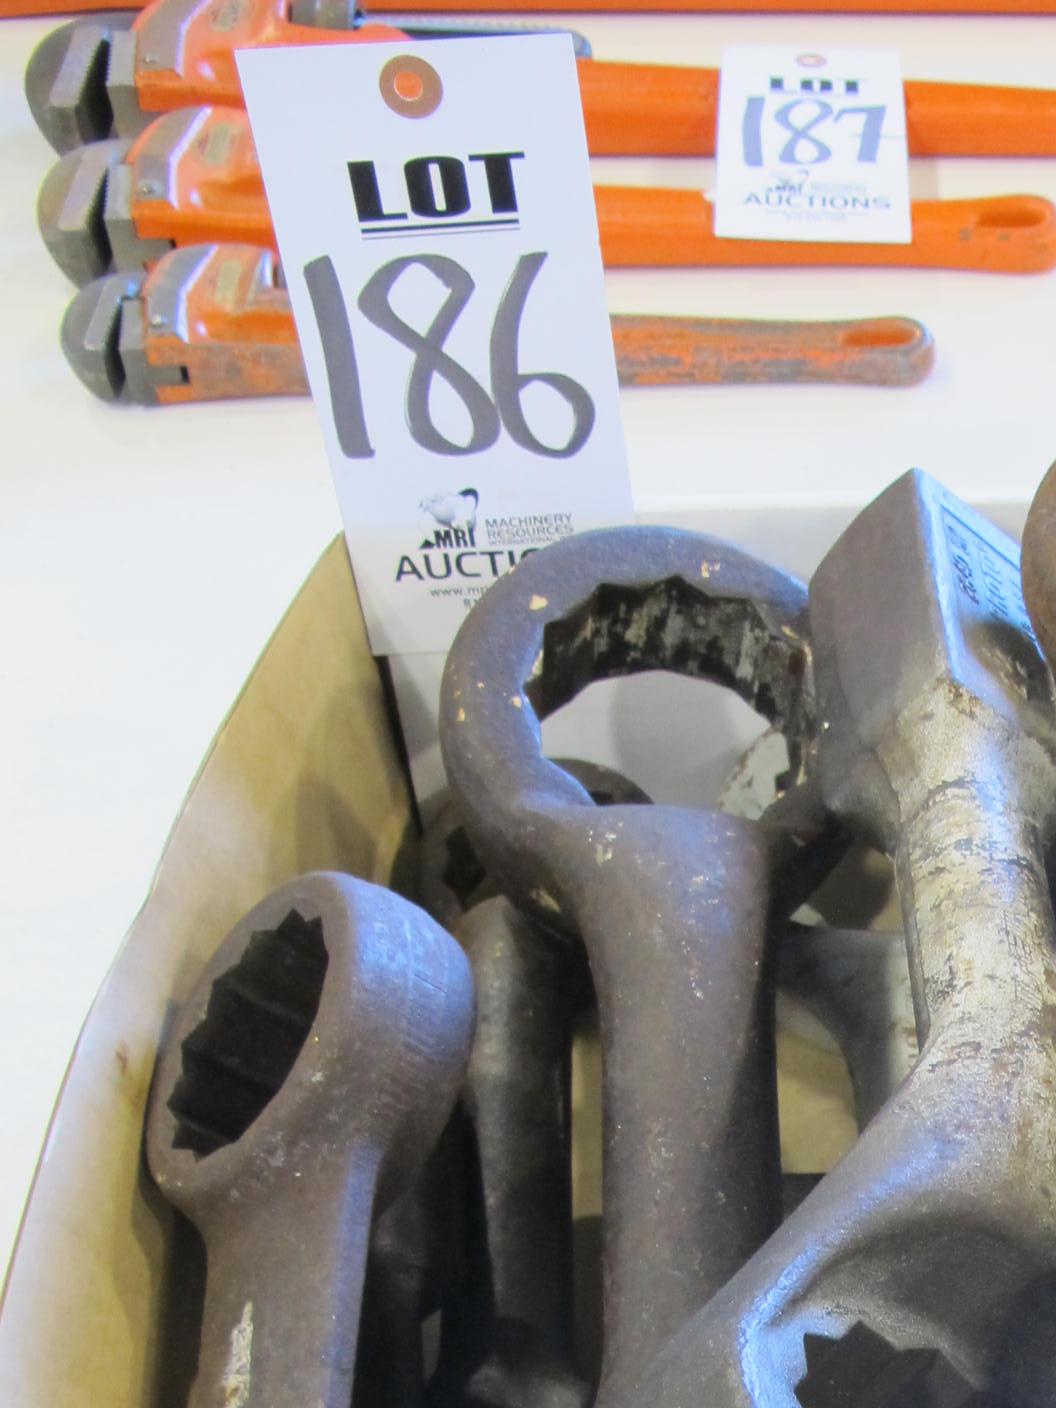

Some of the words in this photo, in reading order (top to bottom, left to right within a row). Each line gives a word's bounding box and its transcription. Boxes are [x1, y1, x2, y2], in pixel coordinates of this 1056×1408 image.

[769, 76, 867, 97] LOT
[741, 96, 887, 168] 187
[347, 151, 525, 223] LOT
[744, 192, 891, 209] AUCTIONS
[303, 251, 597, 459] 186
[485, 512, 573, 529] MACHINERY
[433, 525, 477, 549] MRI
[486, 525, 575, 540] RESOURCES
